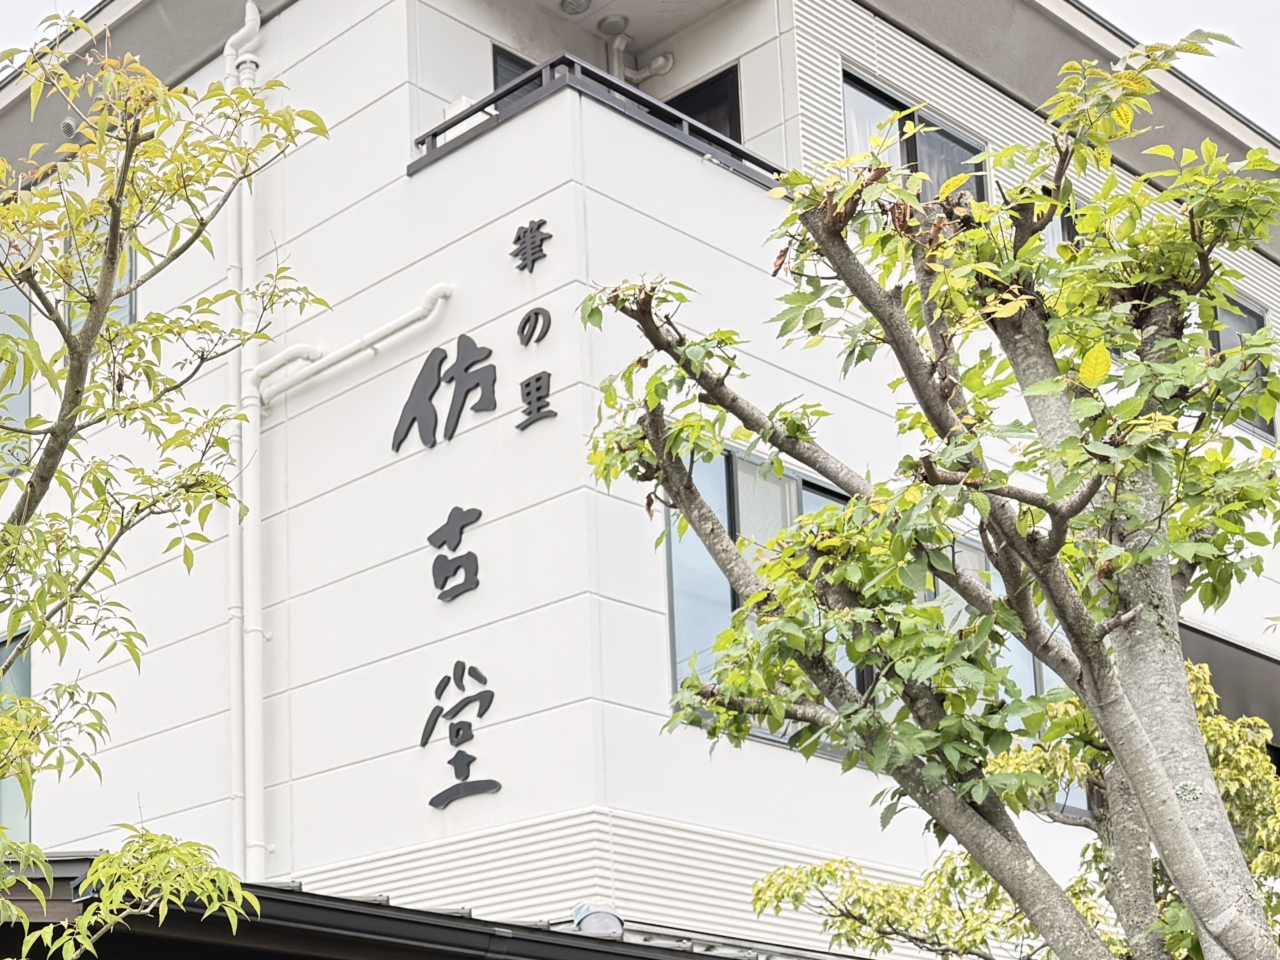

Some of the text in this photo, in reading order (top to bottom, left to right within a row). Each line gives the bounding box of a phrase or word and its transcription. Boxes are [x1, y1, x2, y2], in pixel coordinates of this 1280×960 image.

[509, 219, 558, 432] 筆の里
[392, 335, 501, 809] 仿古堂
